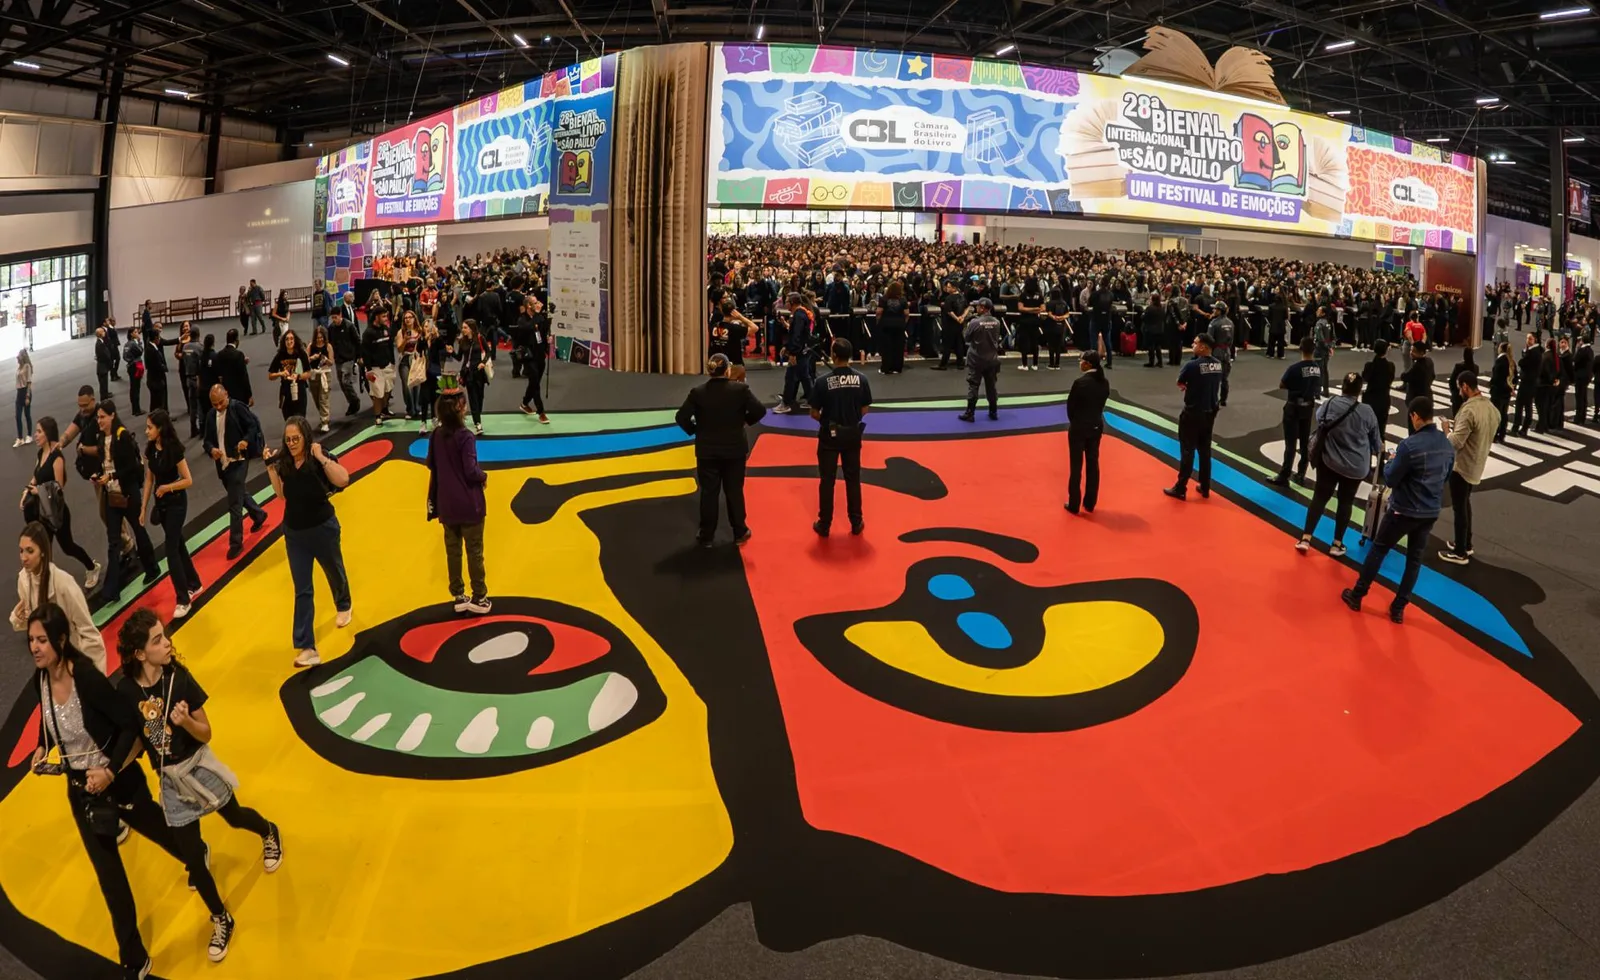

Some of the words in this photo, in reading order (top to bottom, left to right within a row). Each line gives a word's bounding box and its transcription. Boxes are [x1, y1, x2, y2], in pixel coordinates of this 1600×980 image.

[569, 111, 598, 130] BIENAL
[582, 121, 605, 137] LIVRO
[914, 121, 949, 131] Câmara
[1152, 109, 1225, 138] BIENAL
[849, 119, 906, 144] CBL
[913, 130, 957, 139] Brasileira
[1106, 126, 1187, 149] INTERNACIONAL
[561, 136, 574, 149] SÃO
[574, 136, 596, 149] PAULO
[927, 139, 952, 147] Livro
[1190, 135, 1243, 163] LIVRO
[1121, 148, 1133, 160] DE
[1132, 145, 1167, 172] SÃO
[1170, 154, 1221, 181] PAULO
[1130, 179, 1153, 198] UM
[1157, 184, 1219, 206] FESTIVAL
[1222, 193, 1239, 209] DE
[1241, 194, 1295, 217] EMOÇÕES
[840, 374, 860, 385] CAVA
